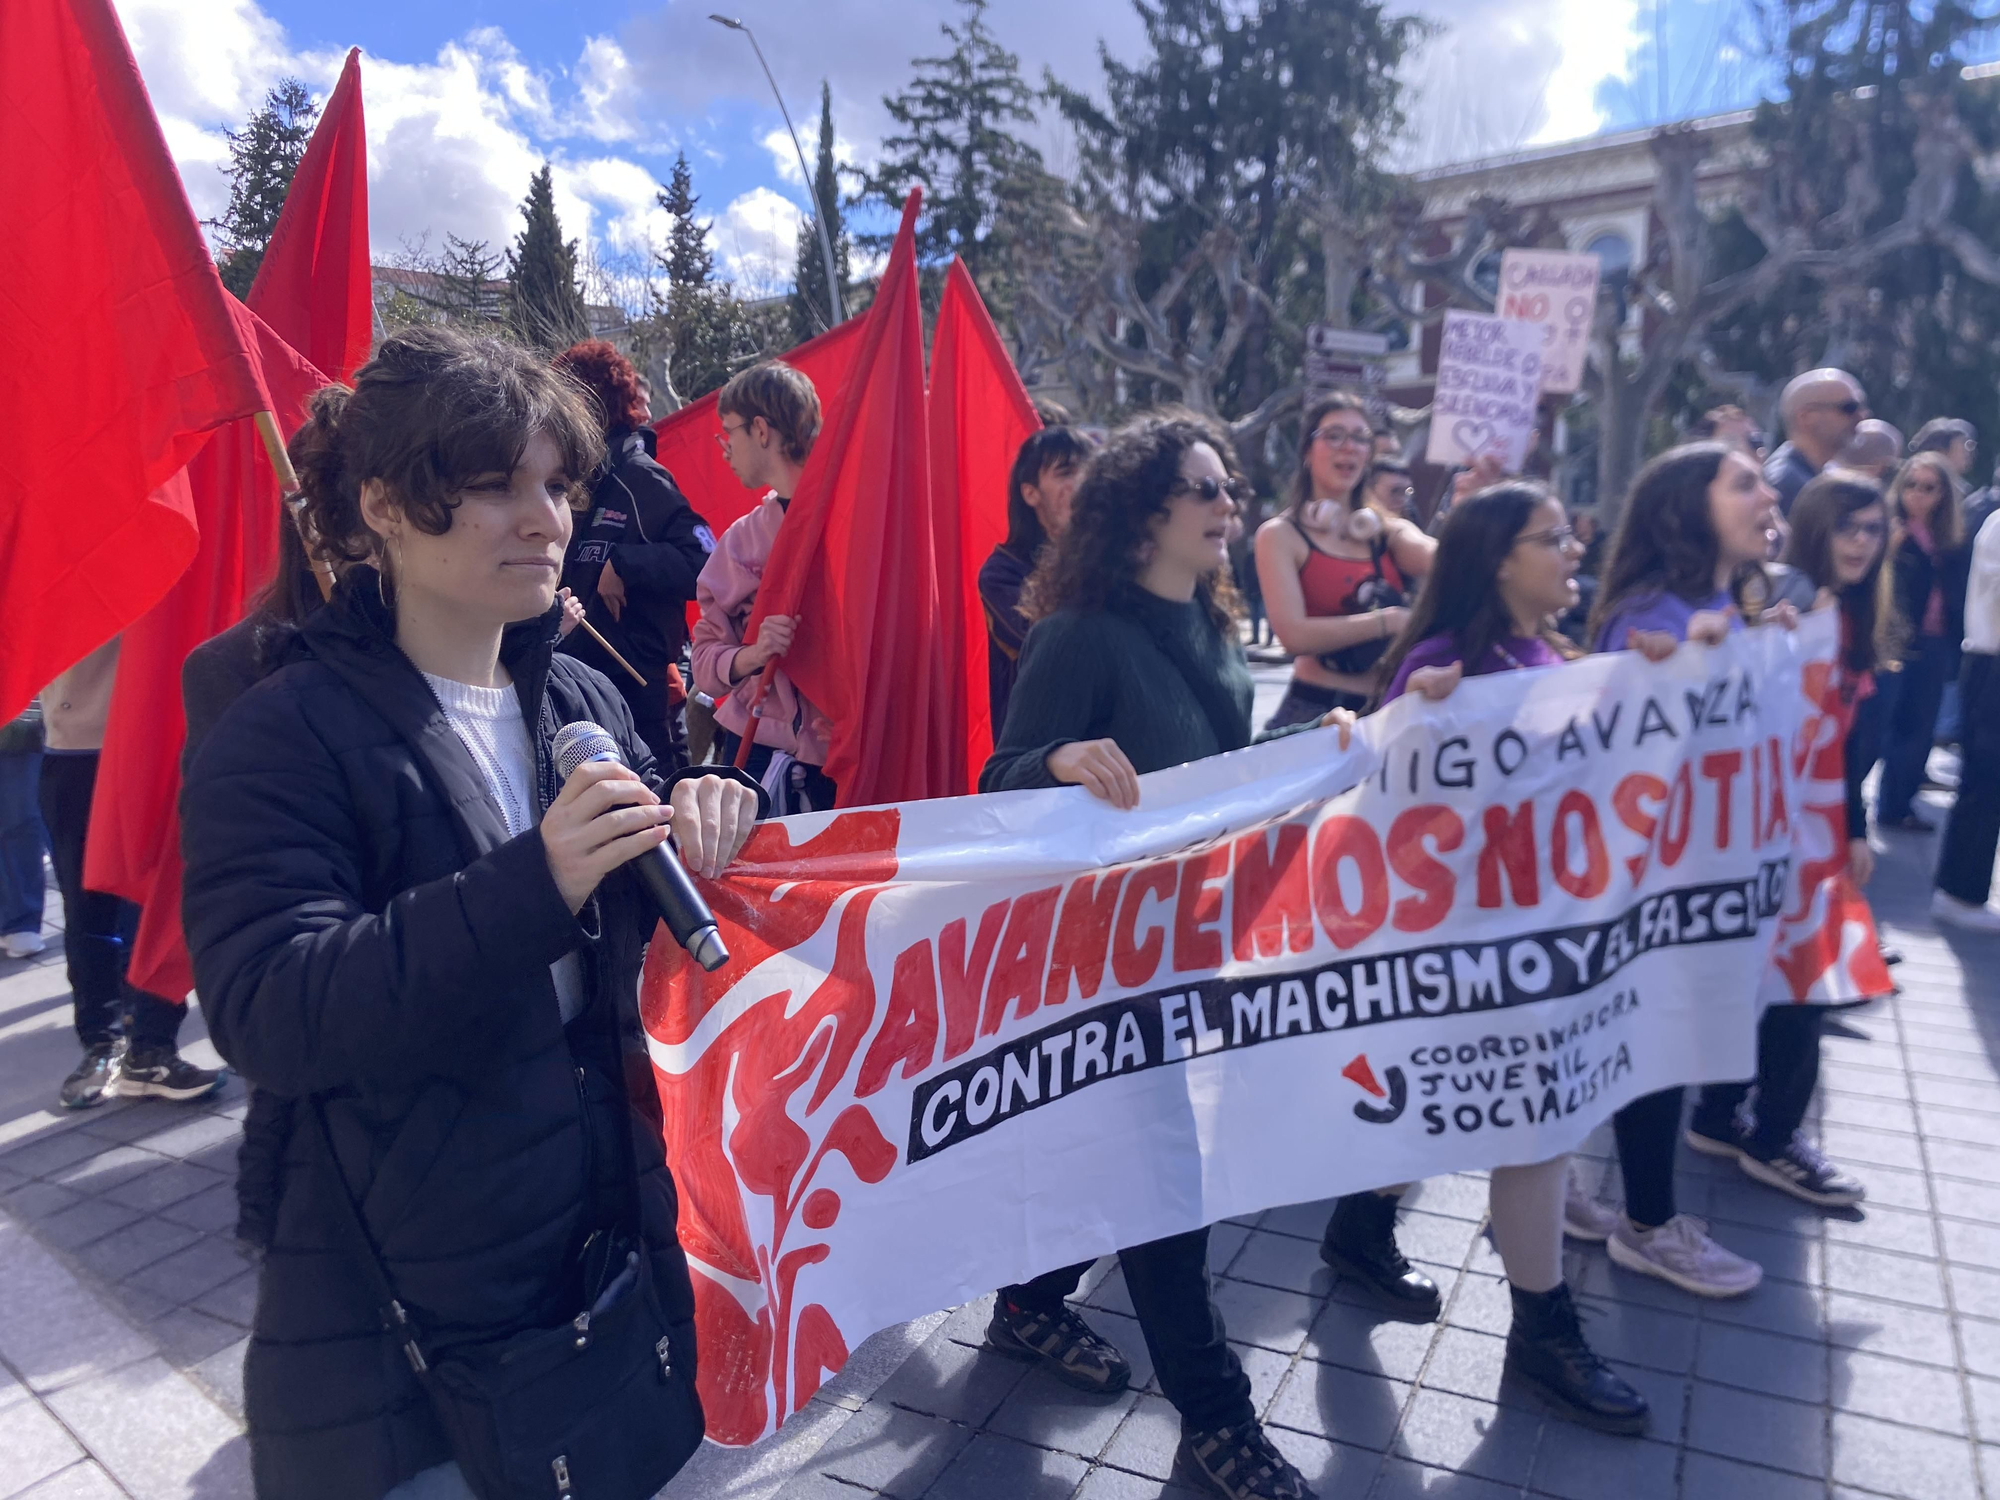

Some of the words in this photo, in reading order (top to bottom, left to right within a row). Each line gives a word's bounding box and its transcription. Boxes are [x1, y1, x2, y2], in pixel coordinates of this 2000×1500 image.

[1503, 292, 1552, 323] NO
[1556, 671, 1758, 762] AVANZA
[855, 805, 1465, 1098] AVANCEMOS
[920, 1012, 1146, 1148] CONTRA
[1162, 991, 1223, 1062] EL
[1231, 940, 1553, 1040] MACHISMO
[1555, 929, 1601, 985] Y
[1603, 920, 1637, 973] EL
[1410, 987, 1641, 1066] COORDINADORA
[1420, 1047, 1588, 1096] JUVENIL
[1422, 1041, 1633, 1135] SOCIALISTA
